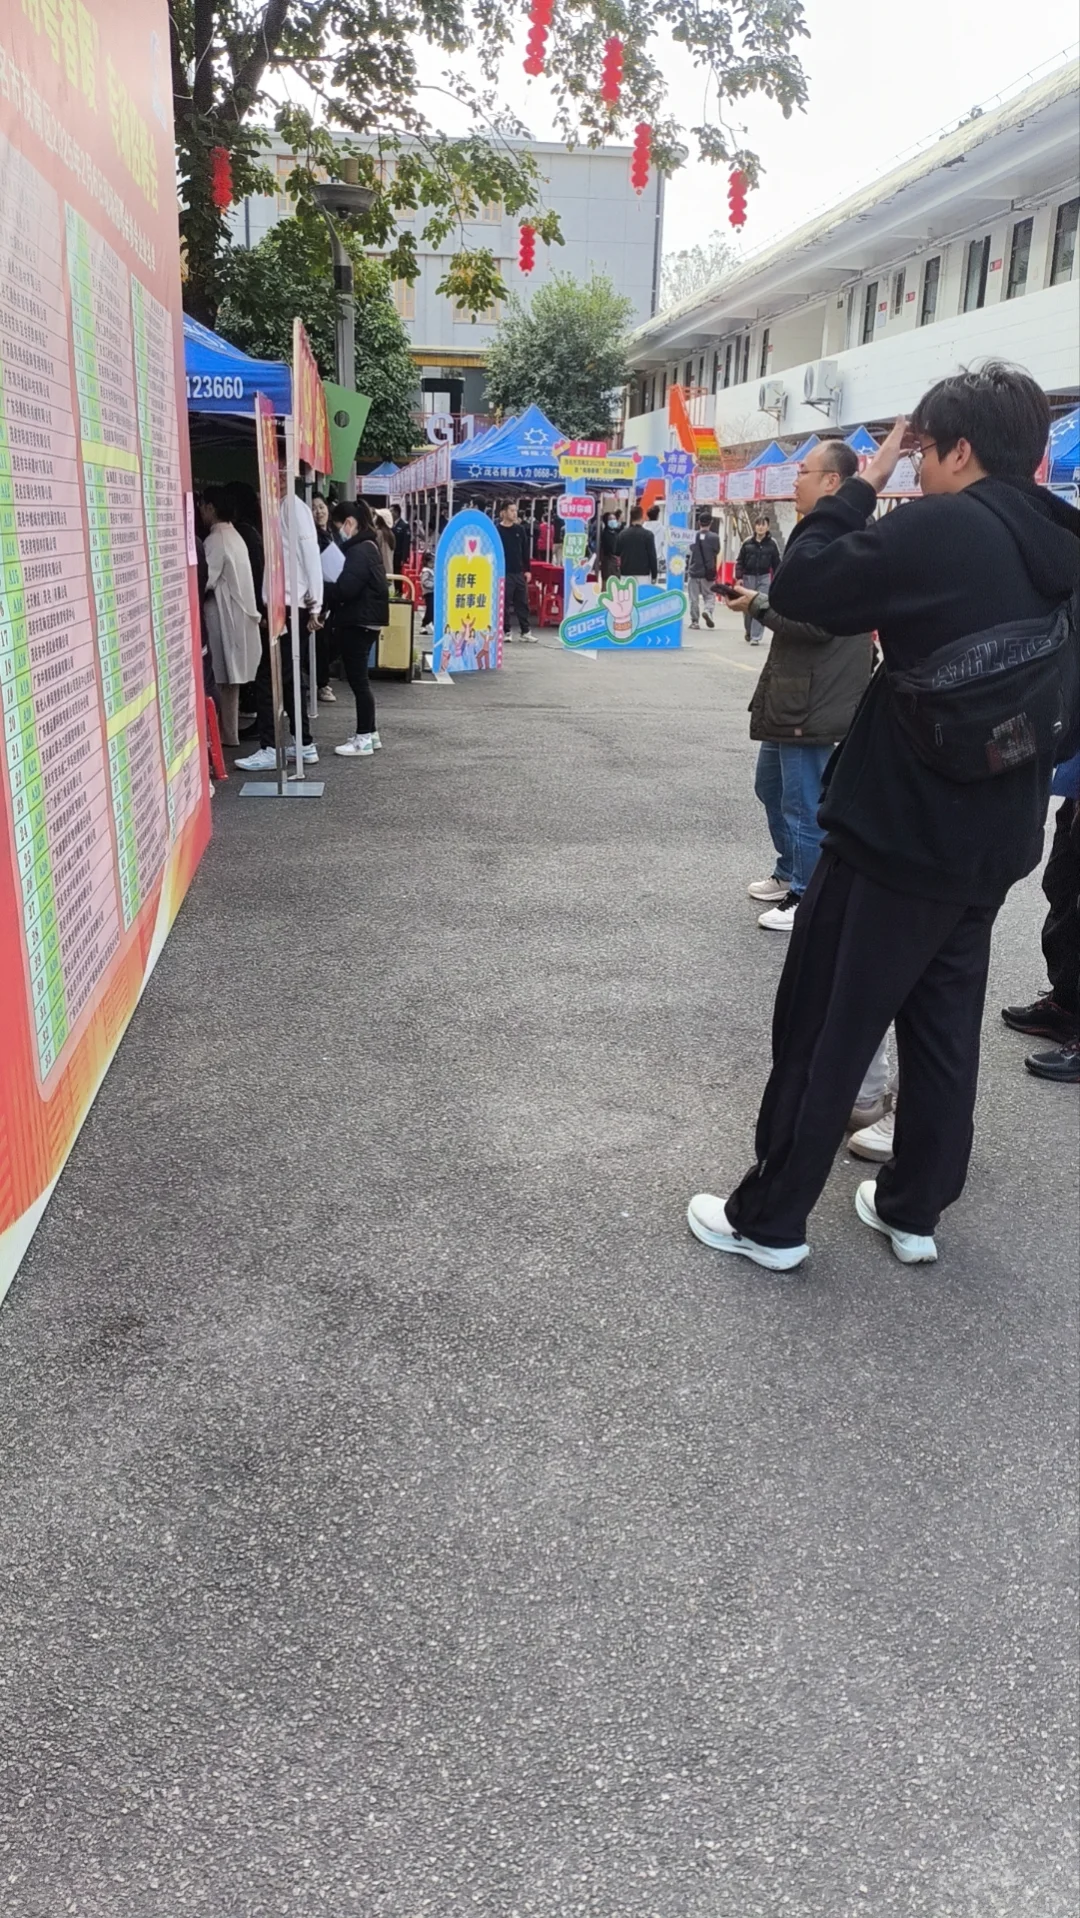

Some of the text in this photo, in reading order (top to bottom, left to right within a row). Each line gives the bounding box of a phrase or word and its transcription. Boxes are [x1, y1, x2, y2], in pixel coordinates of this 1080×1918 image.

[427, 412, 475, 446] G1
[8, 570, 20, 586] A15
[456, 573, 477, 588] 新年
[455, 593, 487, 609] 新事业
[567, 615, 605, 638] 2025
[1, 631, 8, 647] 17
[5, 659, 12, 676] 18
[7, 688, 13, 704] 19
[8, 716, 16, 733] 20
[12, 744, 20, 760] 21
[15, 771, 22, 789] 22
[17, 799, 24, 814] 23
[20, 825, 28, 841] 24
[24, 850, 31, 865] 25
[26, 877, 33, 892] 26
[28, 904, 35, 920] 27
[31, 929, 38, 945] 28
[34, 952, 41, 968] 29
[37, 977, 44, 992] 30
[40, 1003, 47, 1018] 31
[42, 1028, 49, 1043] 32
